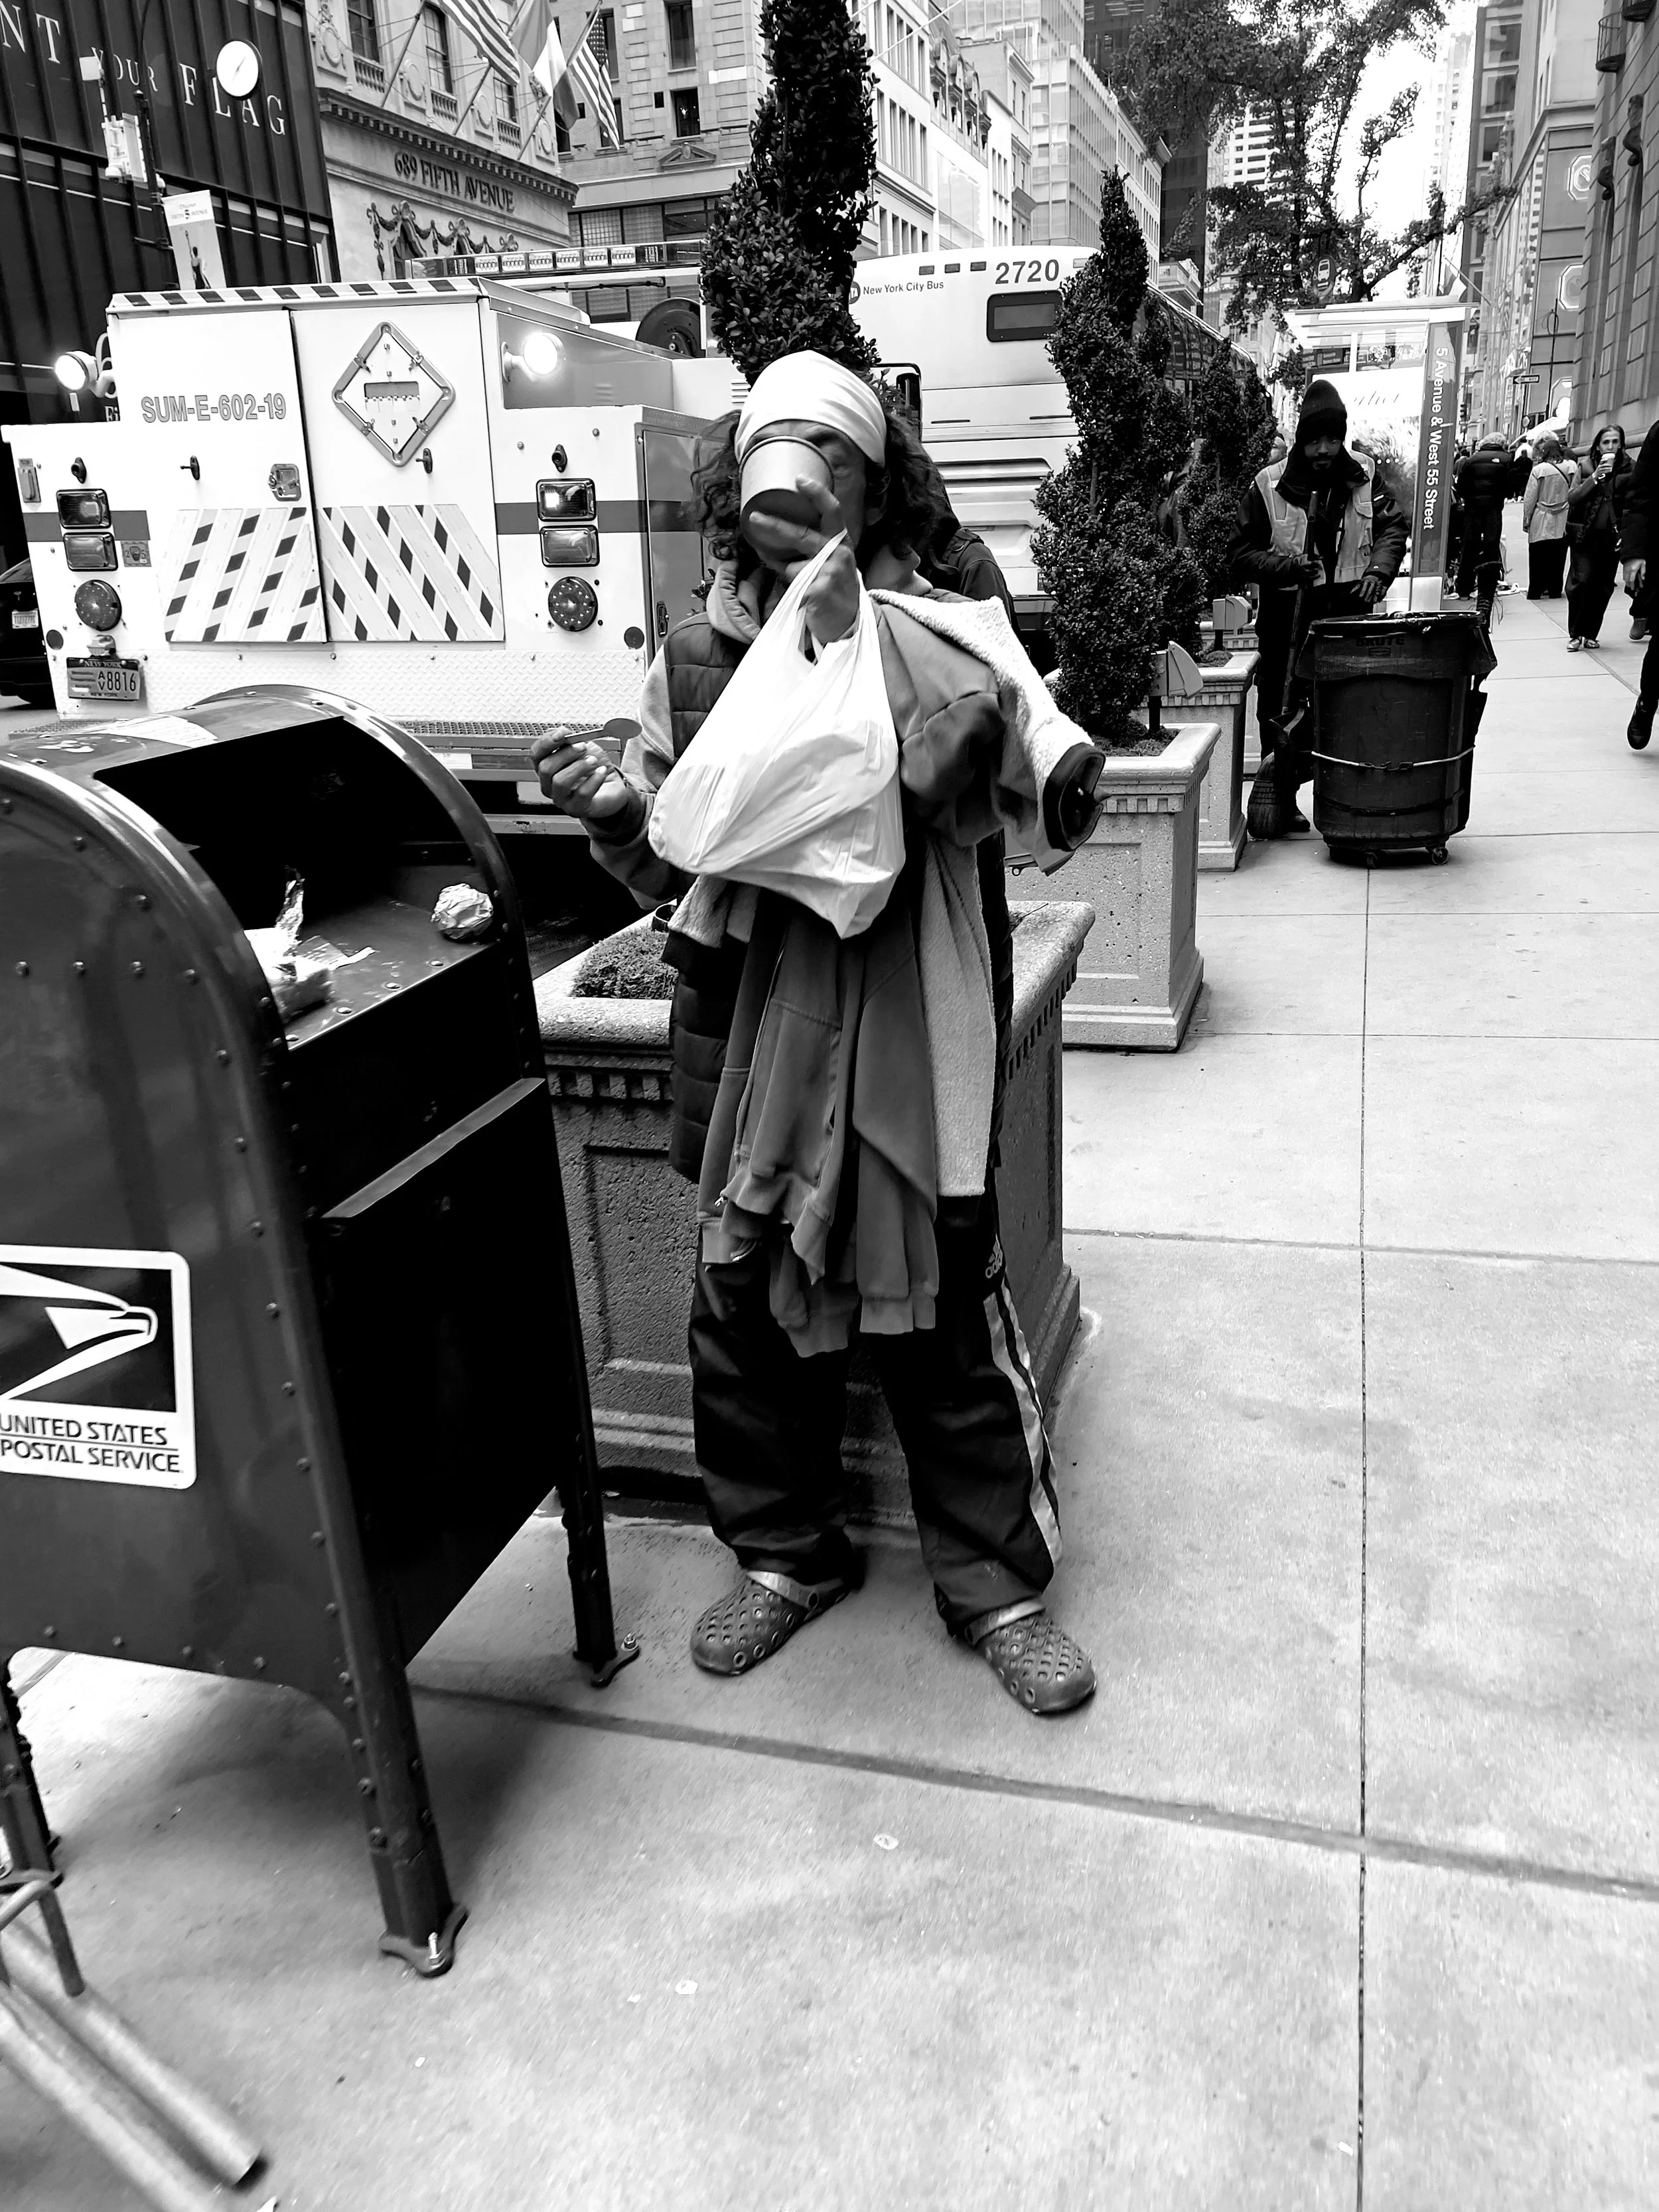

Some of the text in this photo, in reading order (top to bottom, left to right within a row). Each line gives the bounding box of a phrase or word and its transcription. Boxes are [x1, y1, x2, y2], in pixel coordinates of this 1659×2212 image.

[180, 63, 286, 135] FLAG
[394, 152, 516, 214] 689 FIFTH AVENUE
[863, 281, 944, 295] New York City Bus
[995, 259, 1060, 285] 2720
[141, 393, 287, 423] SUM-E-602-19
[1423, 346, 1448, 530] 5 Avenue & West 55 Street
[0, 1413, 167, 1445] UNITED STATES
[0, 1439, 180, 1473] POSTAL SERVICE
